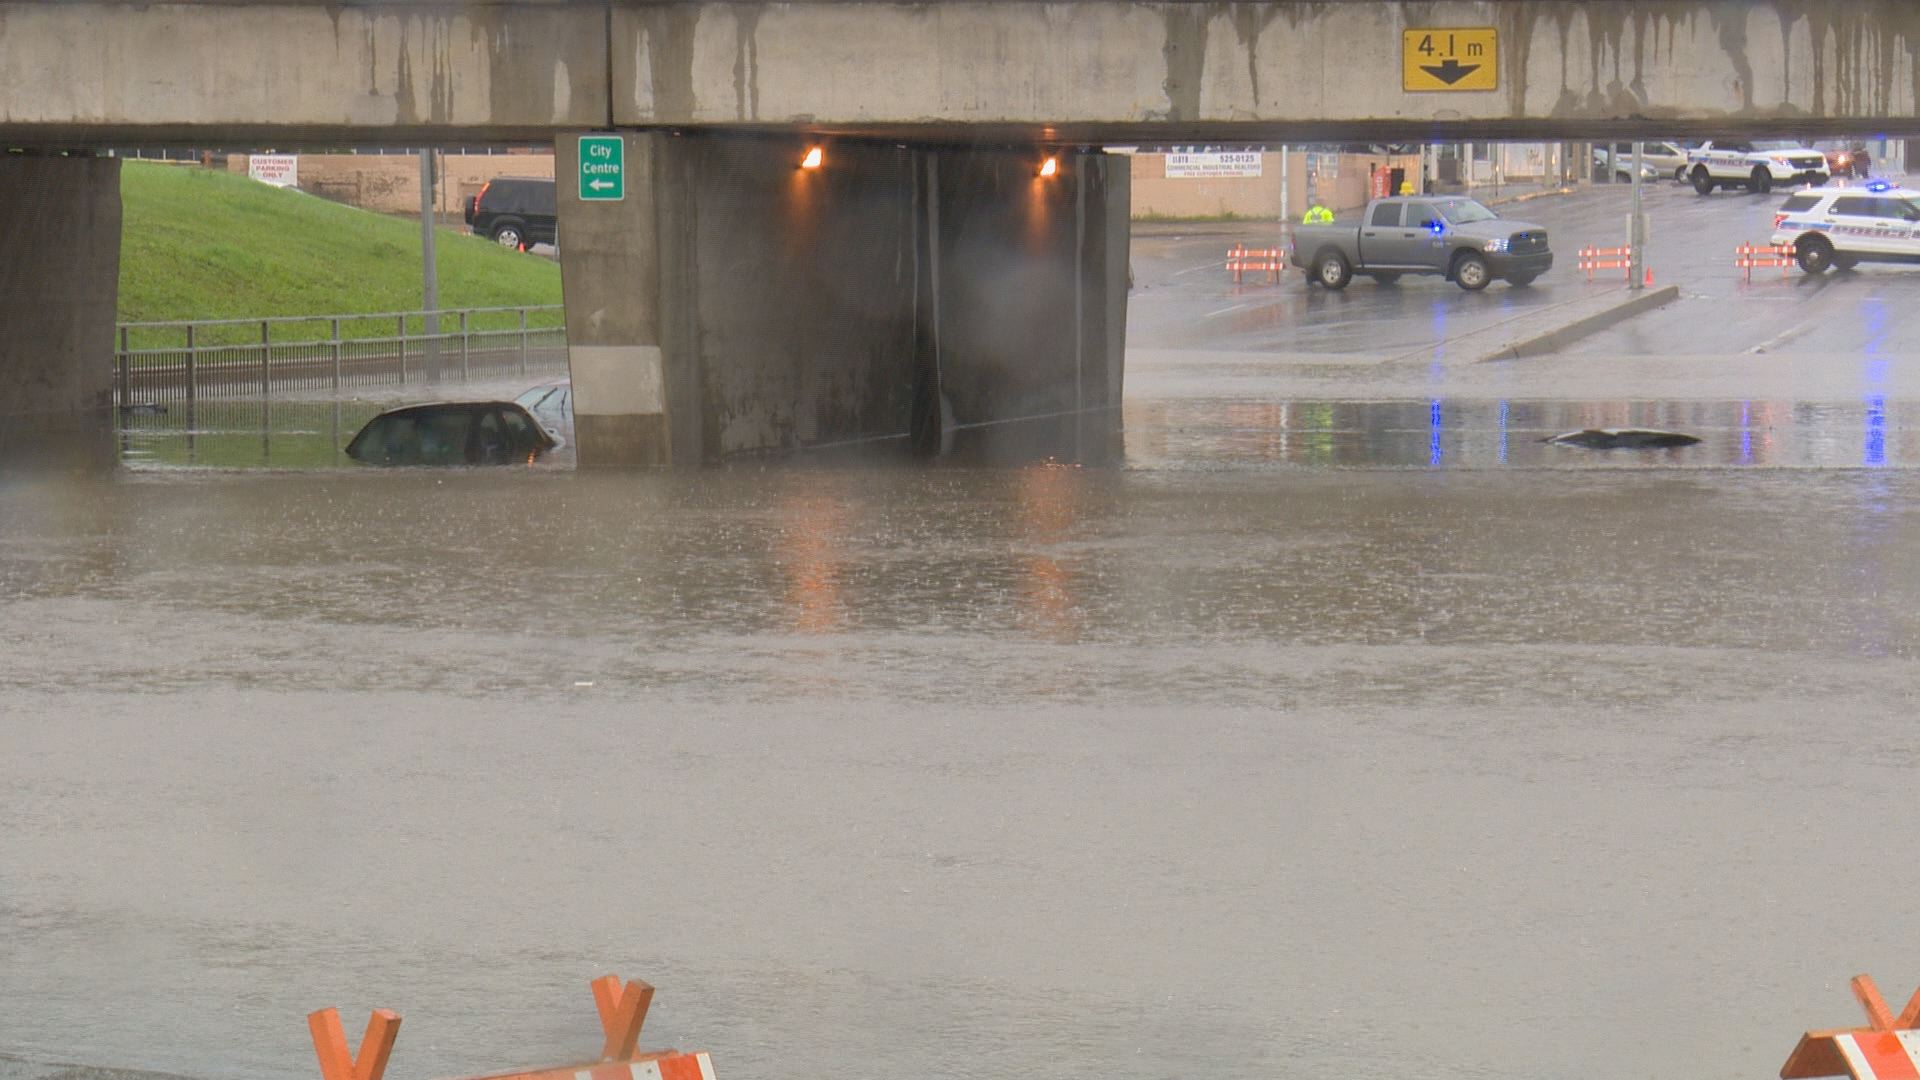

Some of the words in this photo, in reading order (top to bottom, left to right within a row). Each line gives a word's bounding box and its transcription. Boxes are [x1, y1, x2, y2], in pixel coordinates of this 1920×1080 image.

[1418, 34, 1454, 57] 4.1
[1467, 42, 1483, 57] m
[590, 144, 612, 160] City
[583, 162, 619, 174] Centre
